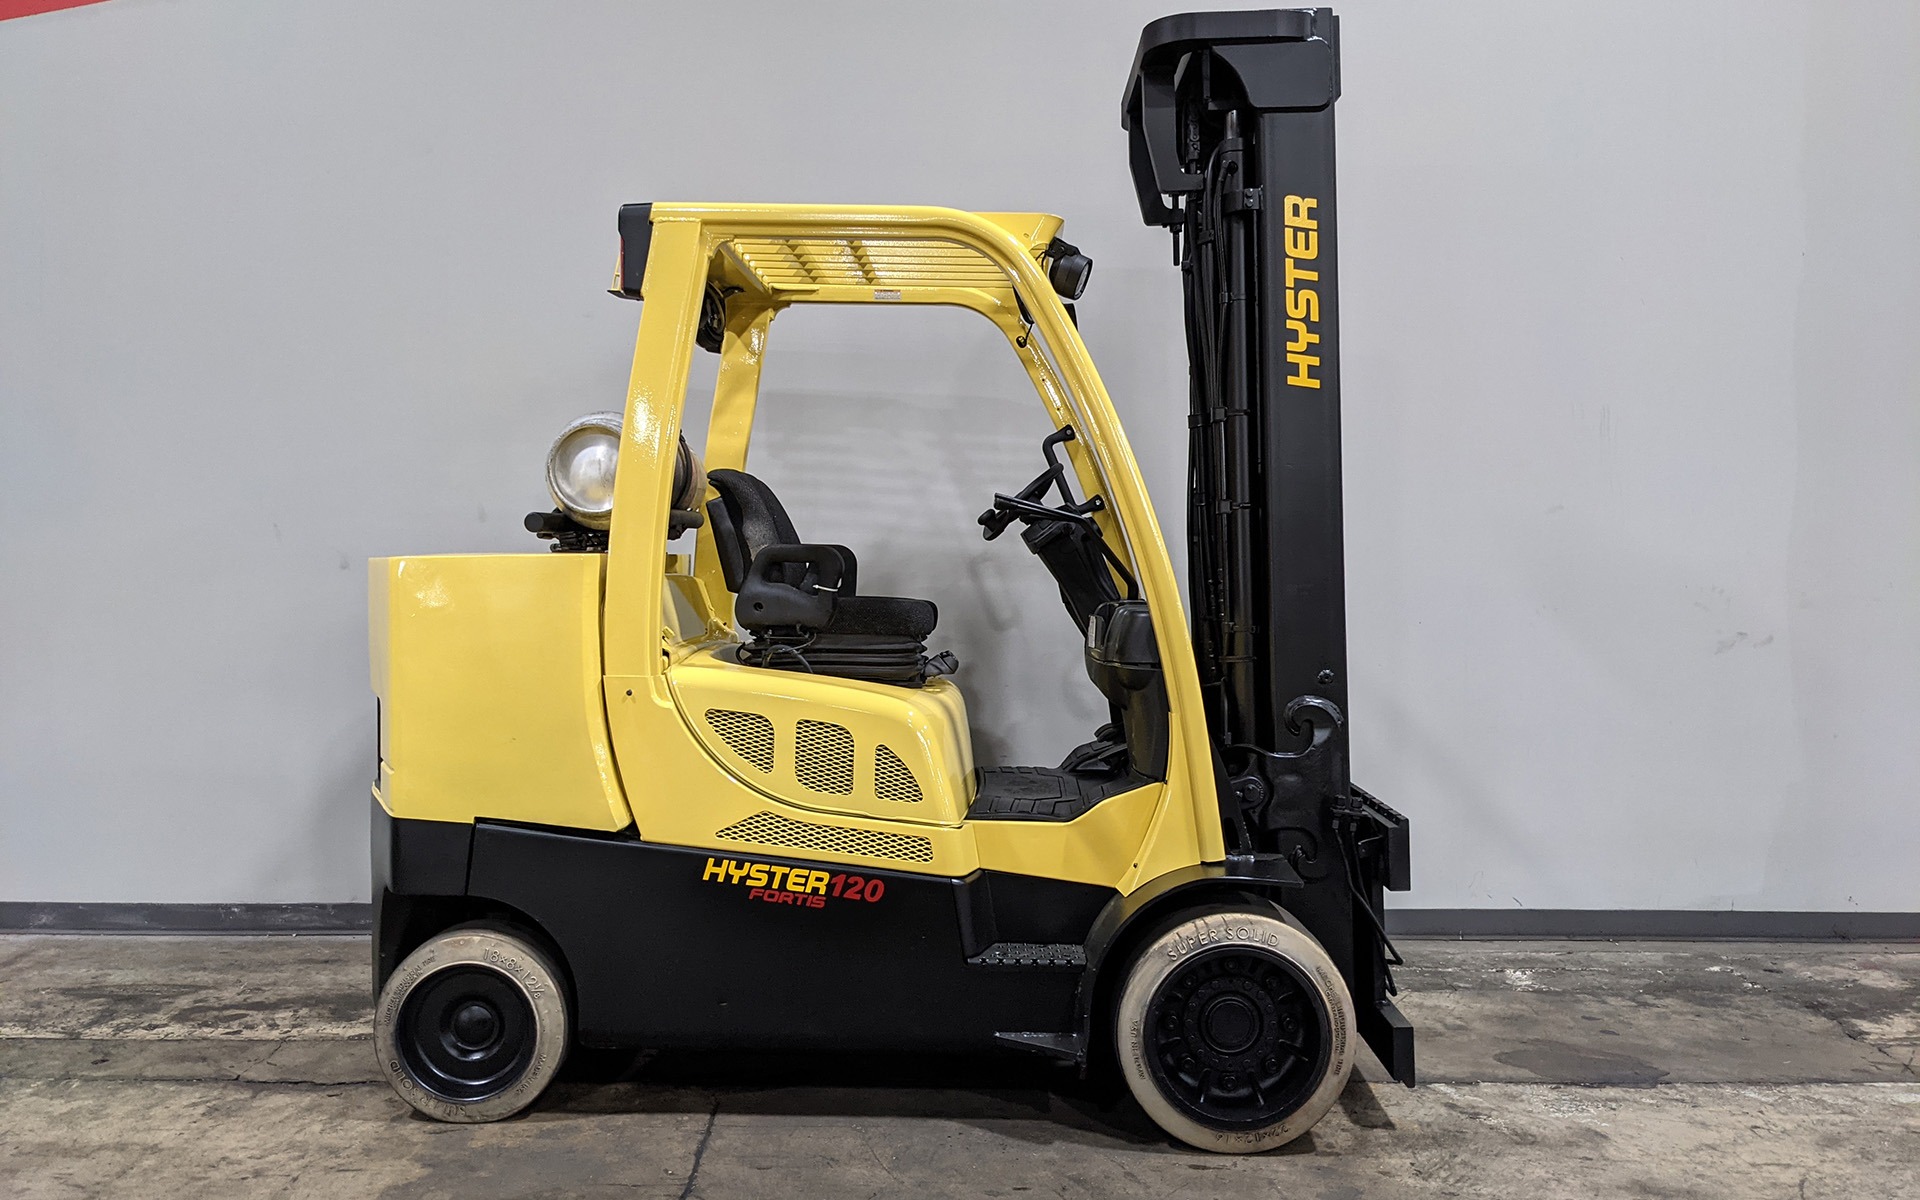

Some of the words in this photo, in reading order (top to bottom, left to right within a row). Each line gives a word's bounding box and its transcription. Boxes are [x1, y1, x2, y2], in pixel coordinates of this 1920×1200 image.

[1284, 195, 1320, 389] HYSTER
[702, 857, 830, 895] HYSTER
[830, 874, 885, 902] 120
[748, 888, 827, 908] FORTIS
[1167, 929, 1218, 961] SUPER
[1226, 926, 1279, 947] SOLID
[389, 1060, 419, 1099] SOLID
